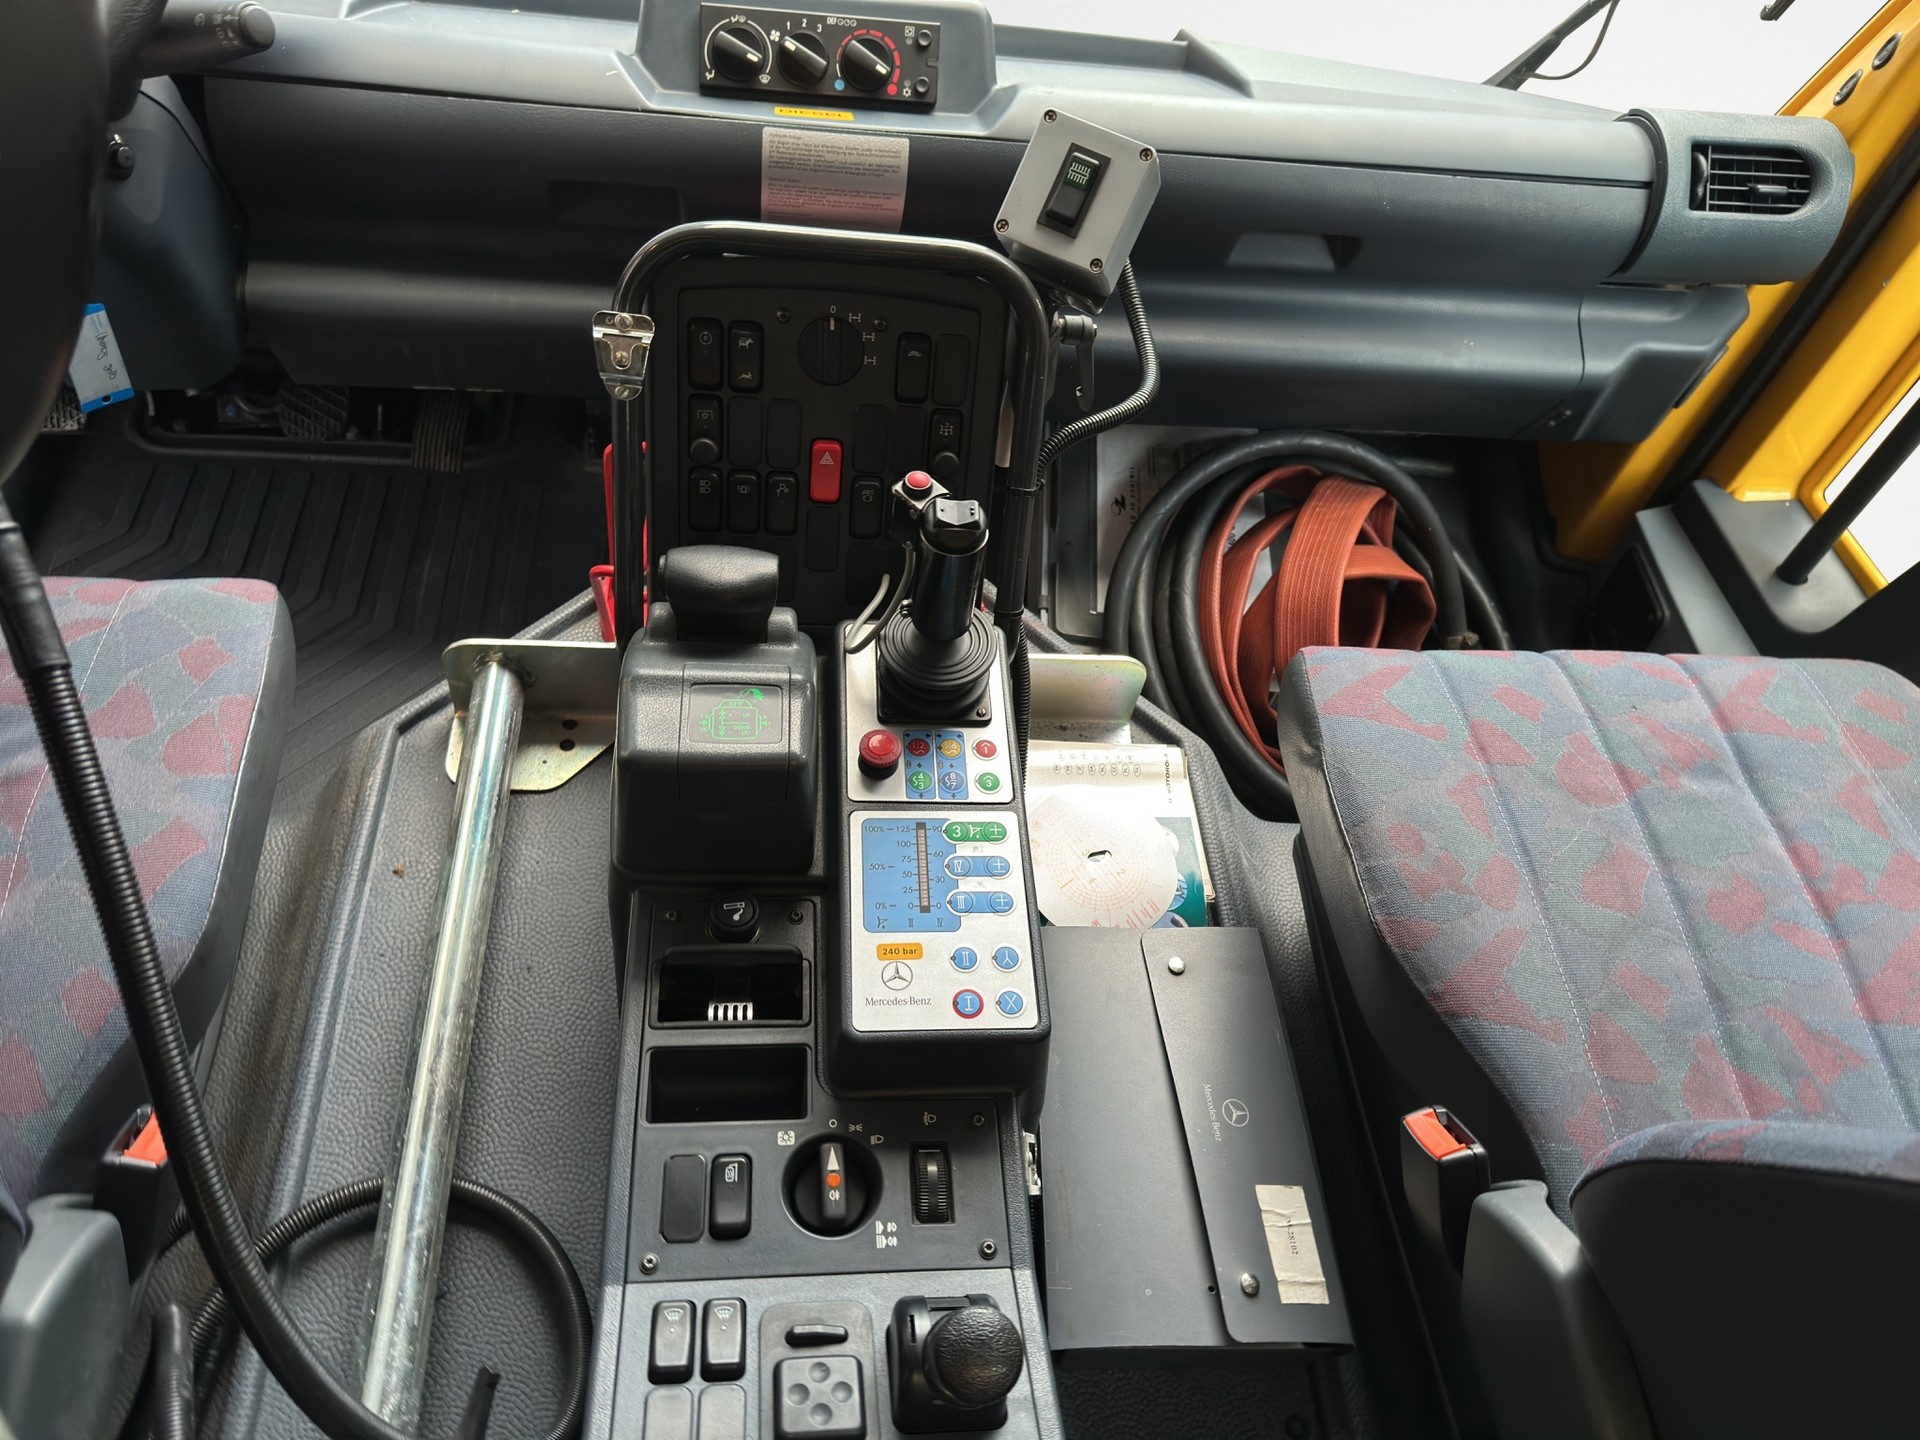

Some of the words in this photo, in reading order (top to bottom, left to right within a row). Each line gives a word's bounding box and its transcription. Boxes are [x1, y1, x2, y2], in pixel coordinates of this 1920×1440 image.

[826, 17, 837, 26] DEF
[786, 21, 791, 30] 1
[802, 19, 807, 27] 2
[816, 24, 822, 33] 3
[830, 305, 837, 314] 0
[918, 772, 924, 780] 4
[950, 772, 956, 780] 8
[918, 782, 924, 790] 3
[950, 782, 957, 790] 7
[986, 780, 992, 788] 3
[952, 825, 962, 838] 3
[933, 850, 944, 858] 60
[869, 863, 886, 871] 50%
[875, 902, 887, 910] 0%
[907, 902, 914, 910] 0
[902, 947, 917, 955] bar
[865, 996, 932, 1007] Mercedes-Benz
[1202, 1083, 1222, 1142] Mercedes-Benz
